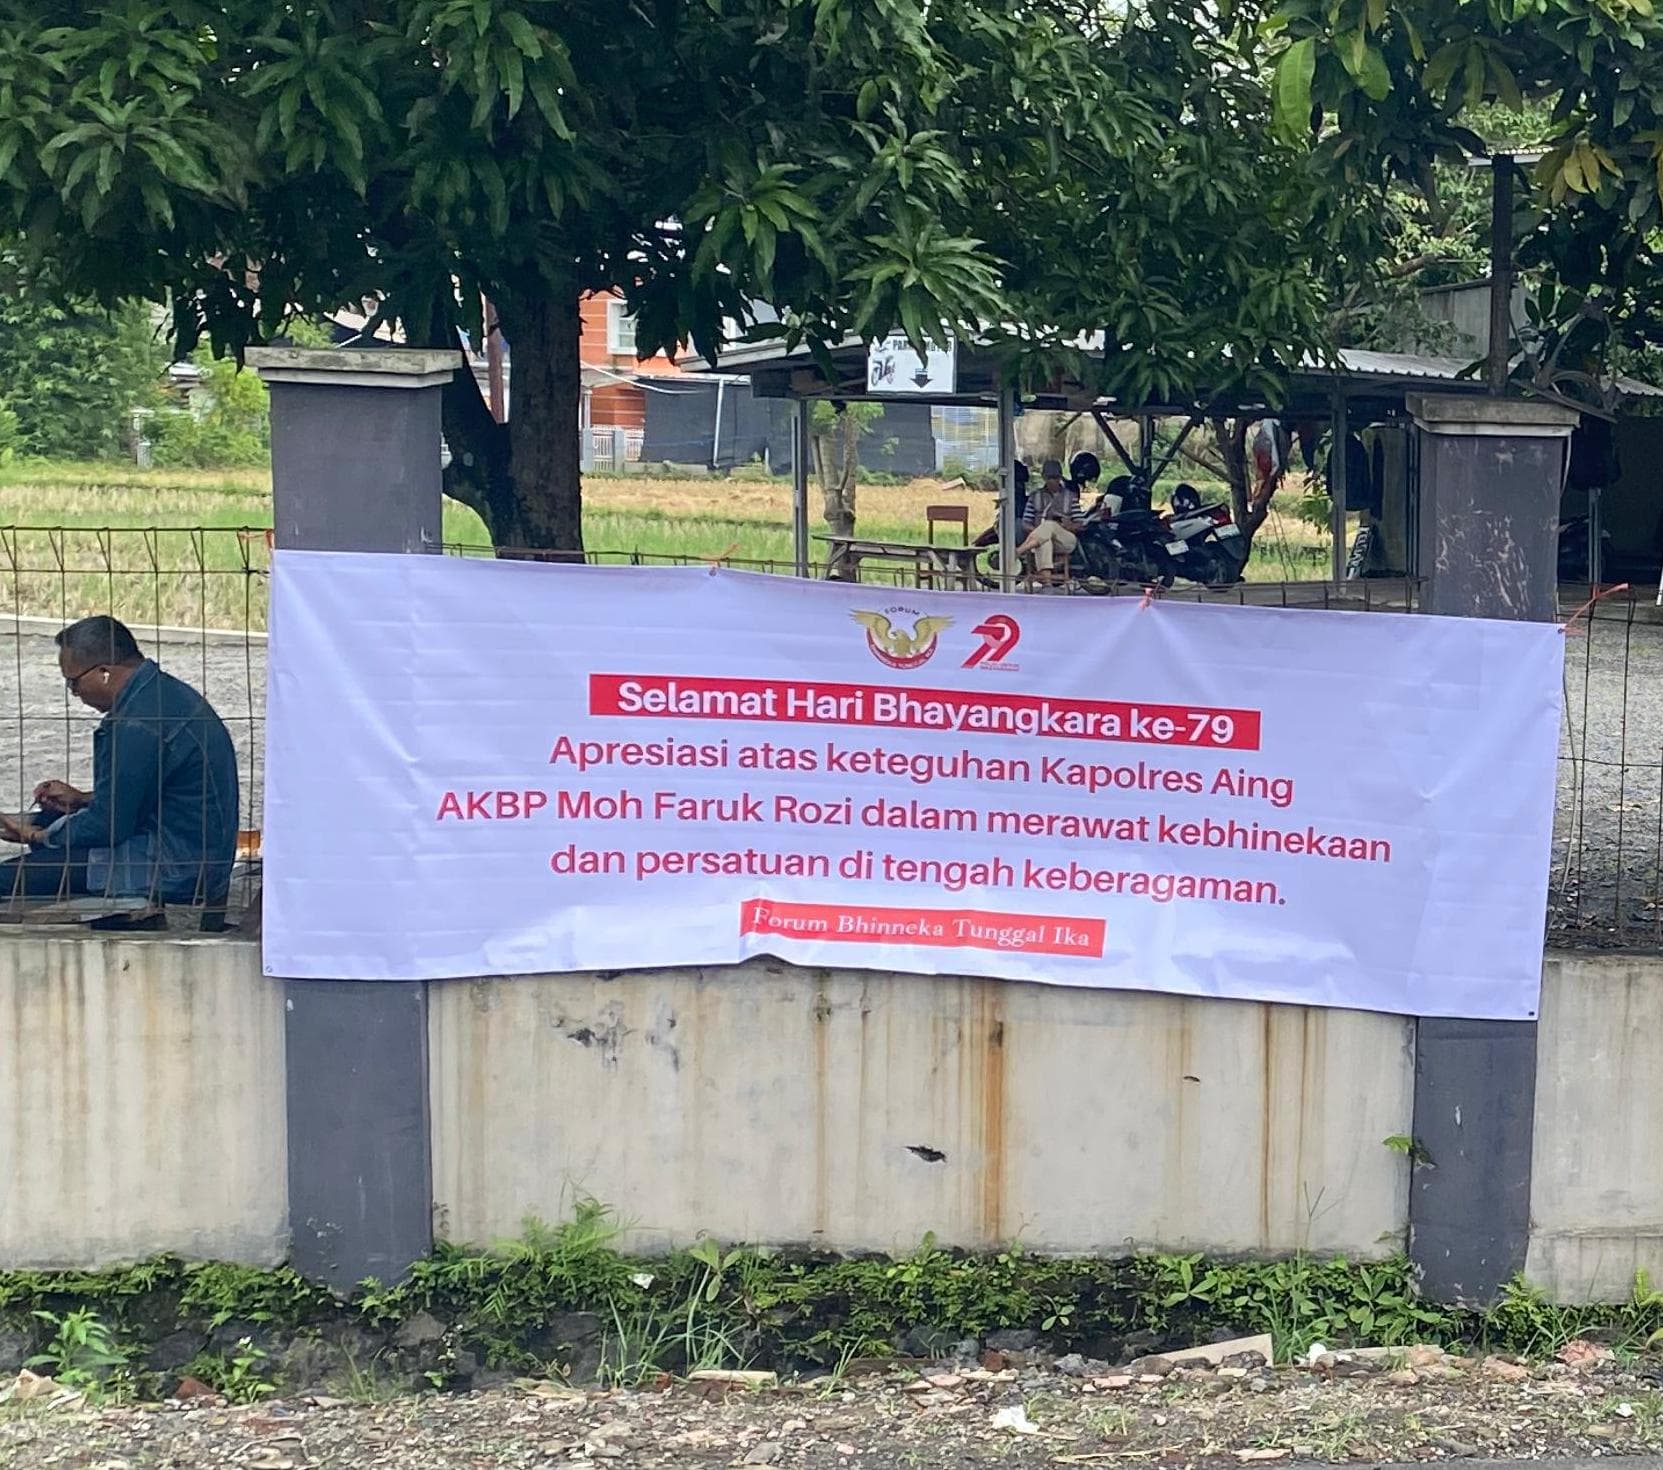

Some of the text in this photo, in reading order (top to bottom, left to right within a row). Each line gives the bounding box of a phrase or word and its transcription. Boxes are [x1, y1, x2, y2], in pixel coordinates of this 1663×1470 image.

[618, 680, 1235, 744] Selamat Hari Bhayangkara ke-79
[549, 735, 1295, 808] Apresiasi atas keteguhan Kapolres Aing
[436, 790, 1392, 863] AKBP Moh Faruk Rozi dalam merawat kebhinekaan
[550, 843, 1287, 906] dan persatuan di tengah keberagaman.
[752, 906, 1091, 947] Forum Bhinneka Tunggal Ika
